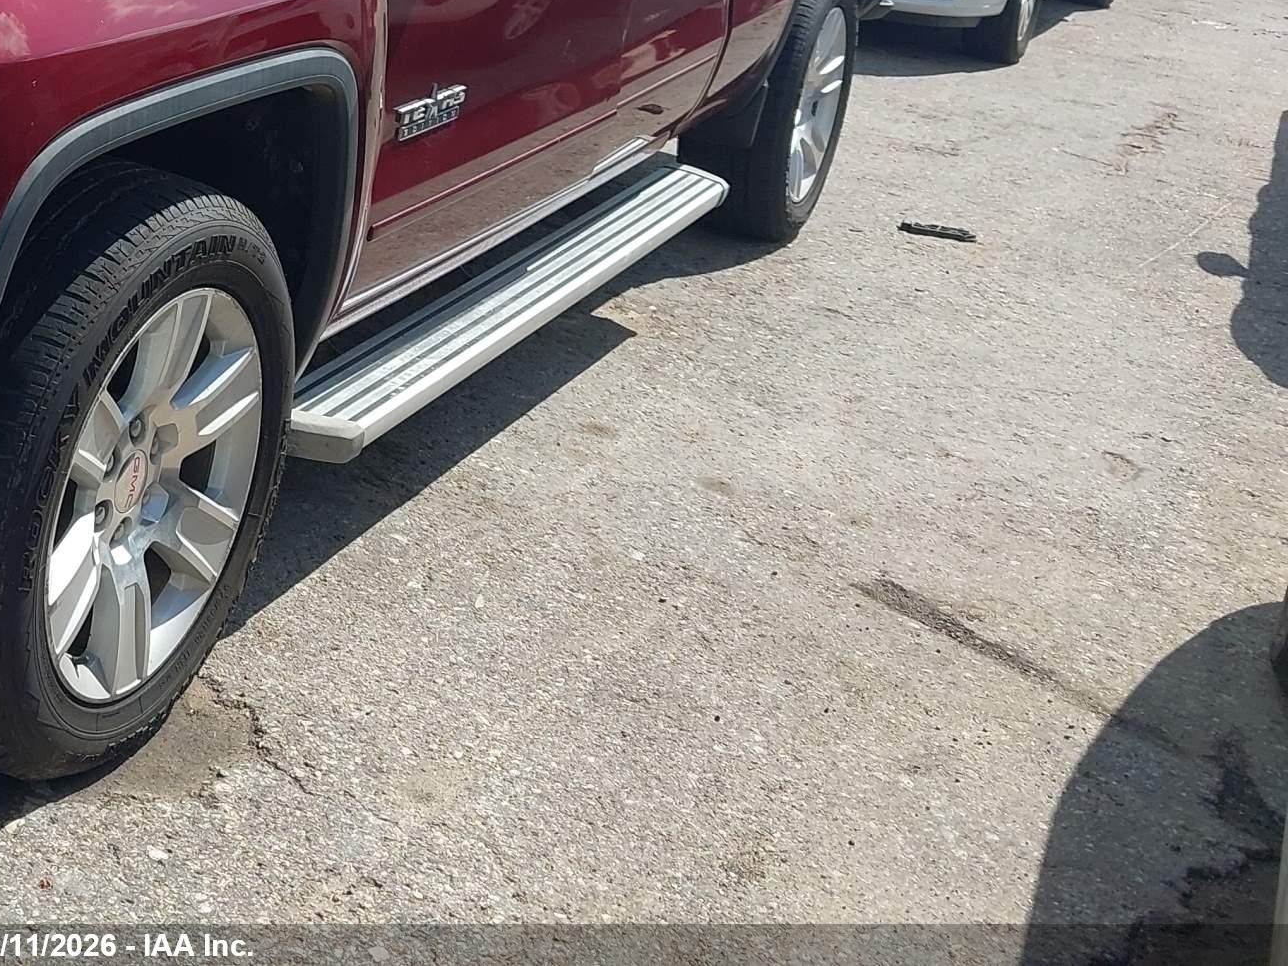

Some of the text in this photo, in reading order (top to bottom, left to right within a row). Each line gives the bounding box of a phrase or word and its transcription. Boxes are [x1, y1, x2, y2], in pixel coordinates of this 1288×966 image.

[393, 83, 468, 125] TEXAS
[81, 234, 237, 386] MOUNTAIN
[123, 456, 141, 508] GMC
